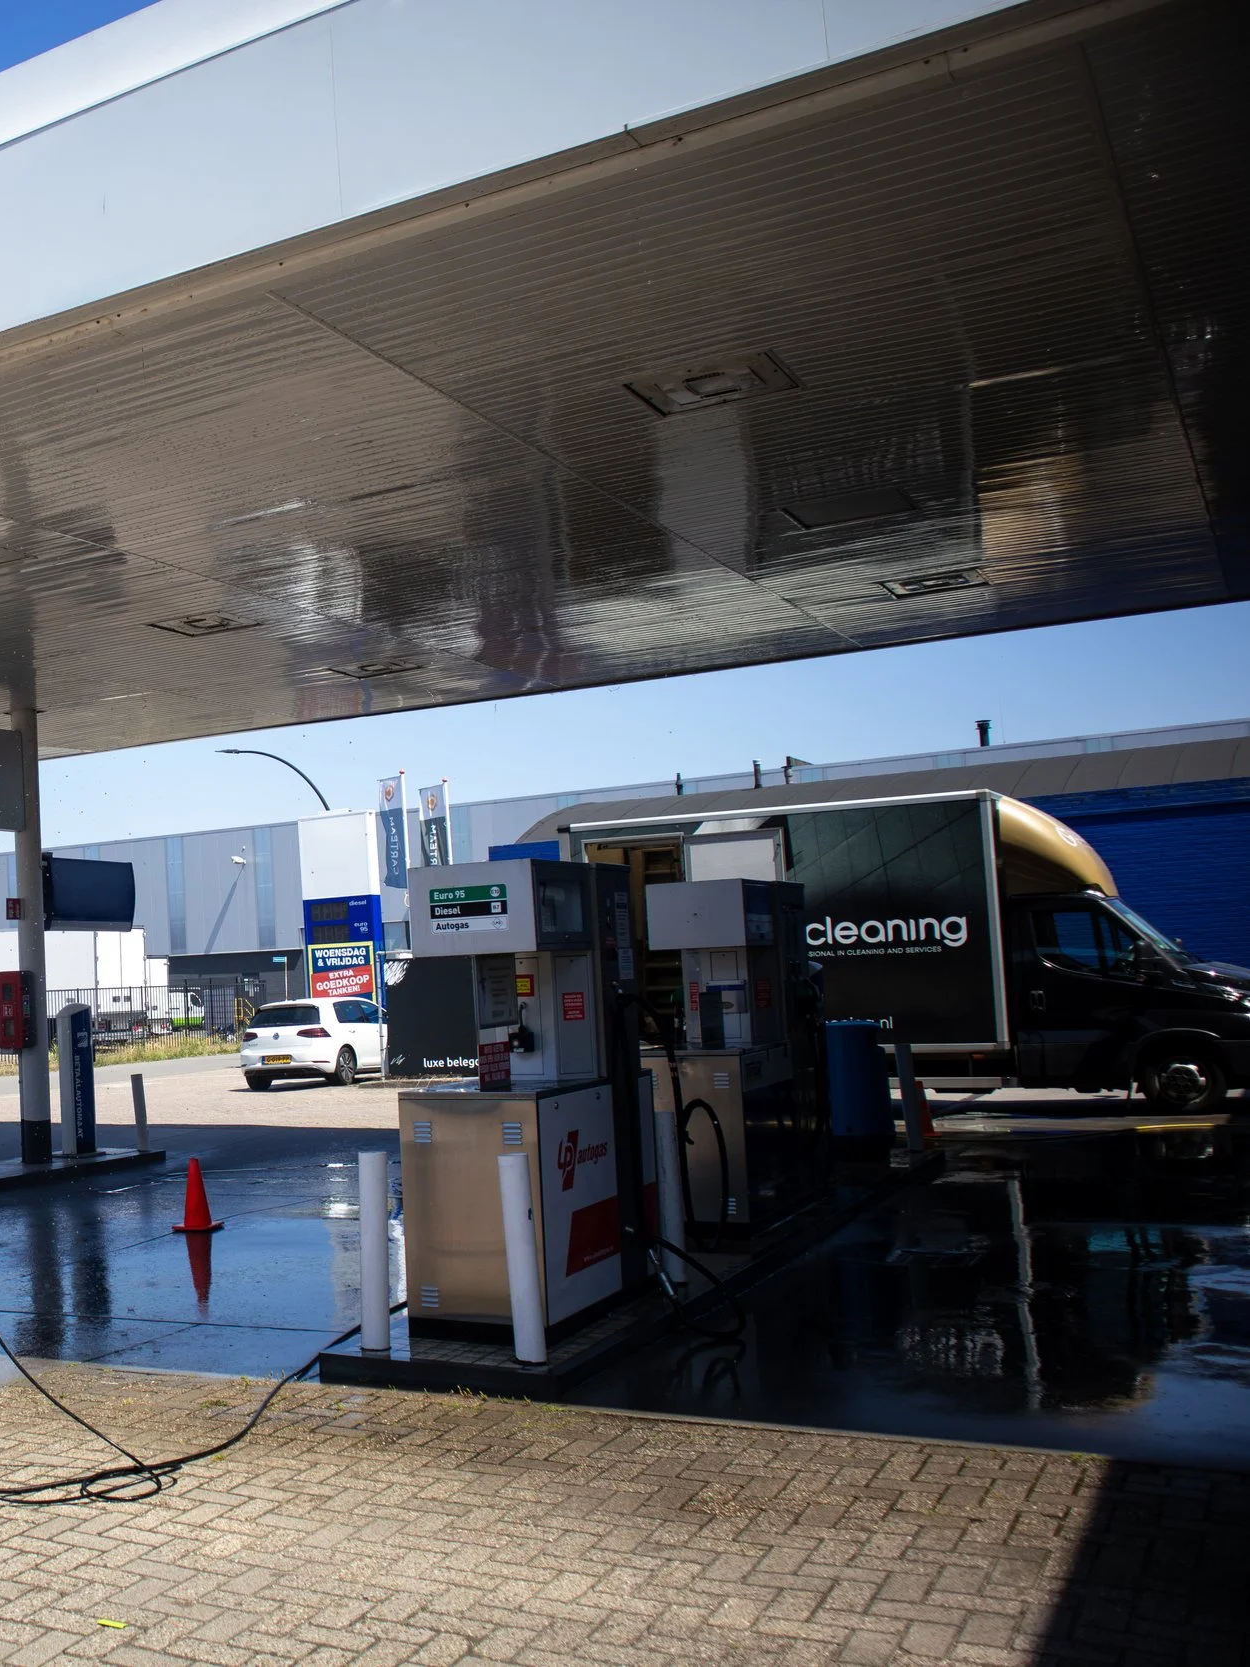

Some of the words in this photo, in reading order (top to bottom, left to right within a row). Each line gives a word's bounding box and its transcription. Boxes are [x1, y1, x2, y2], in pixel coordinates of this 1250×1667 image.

[433, 892, 454, 900] Euro
[455, 890, 466, 898] 95
[434, 906, 461, 915] Diesel
[436, 922, 470, 931] Autogas
[806, 916, 968, 947] cleaning
[315, 948, 366, 958] WOENSDAG
[846, 948, 885, 956] CLEANING
[905, 946, 942, 954] SERVICES
[317, 959, 324, 967] &
[326, 957, 365, 966] VRIJDAG
[329, 970, 354, 979] EXTRA
[316, 975, 370, 990] GOEDKOOP
[327, 985, 361, 997] TANKEN!
[423, 1057, 445, 1068] luxe
[577, 1142, 607, 1165] autogas
